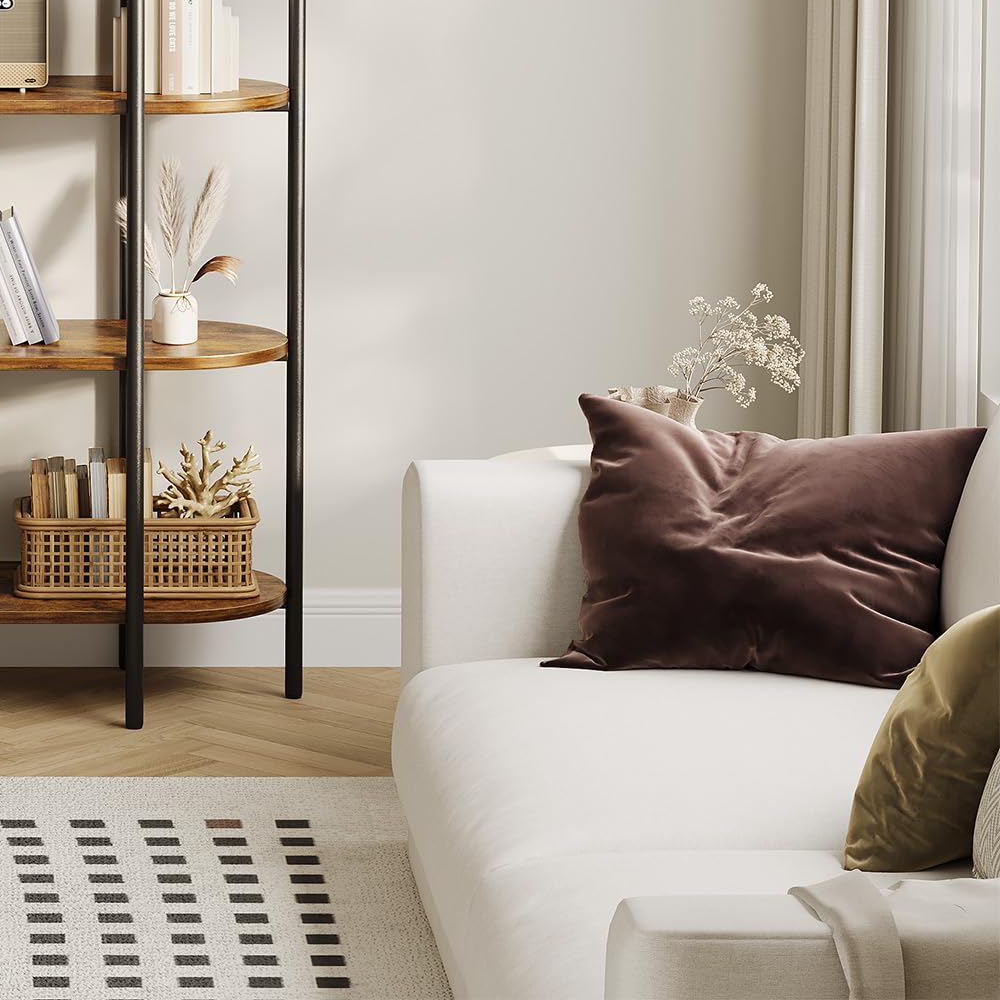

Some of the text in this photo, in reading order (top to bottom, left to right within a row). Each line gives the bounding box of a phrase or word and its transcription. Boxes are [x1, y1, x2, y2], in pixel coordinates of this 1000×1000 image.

[168, 2, 176, 10] DO
[168, 12, 176, 21] WE
[168, 22, 176, 36] LOVE
[168, 37, 176, 52] CATS
